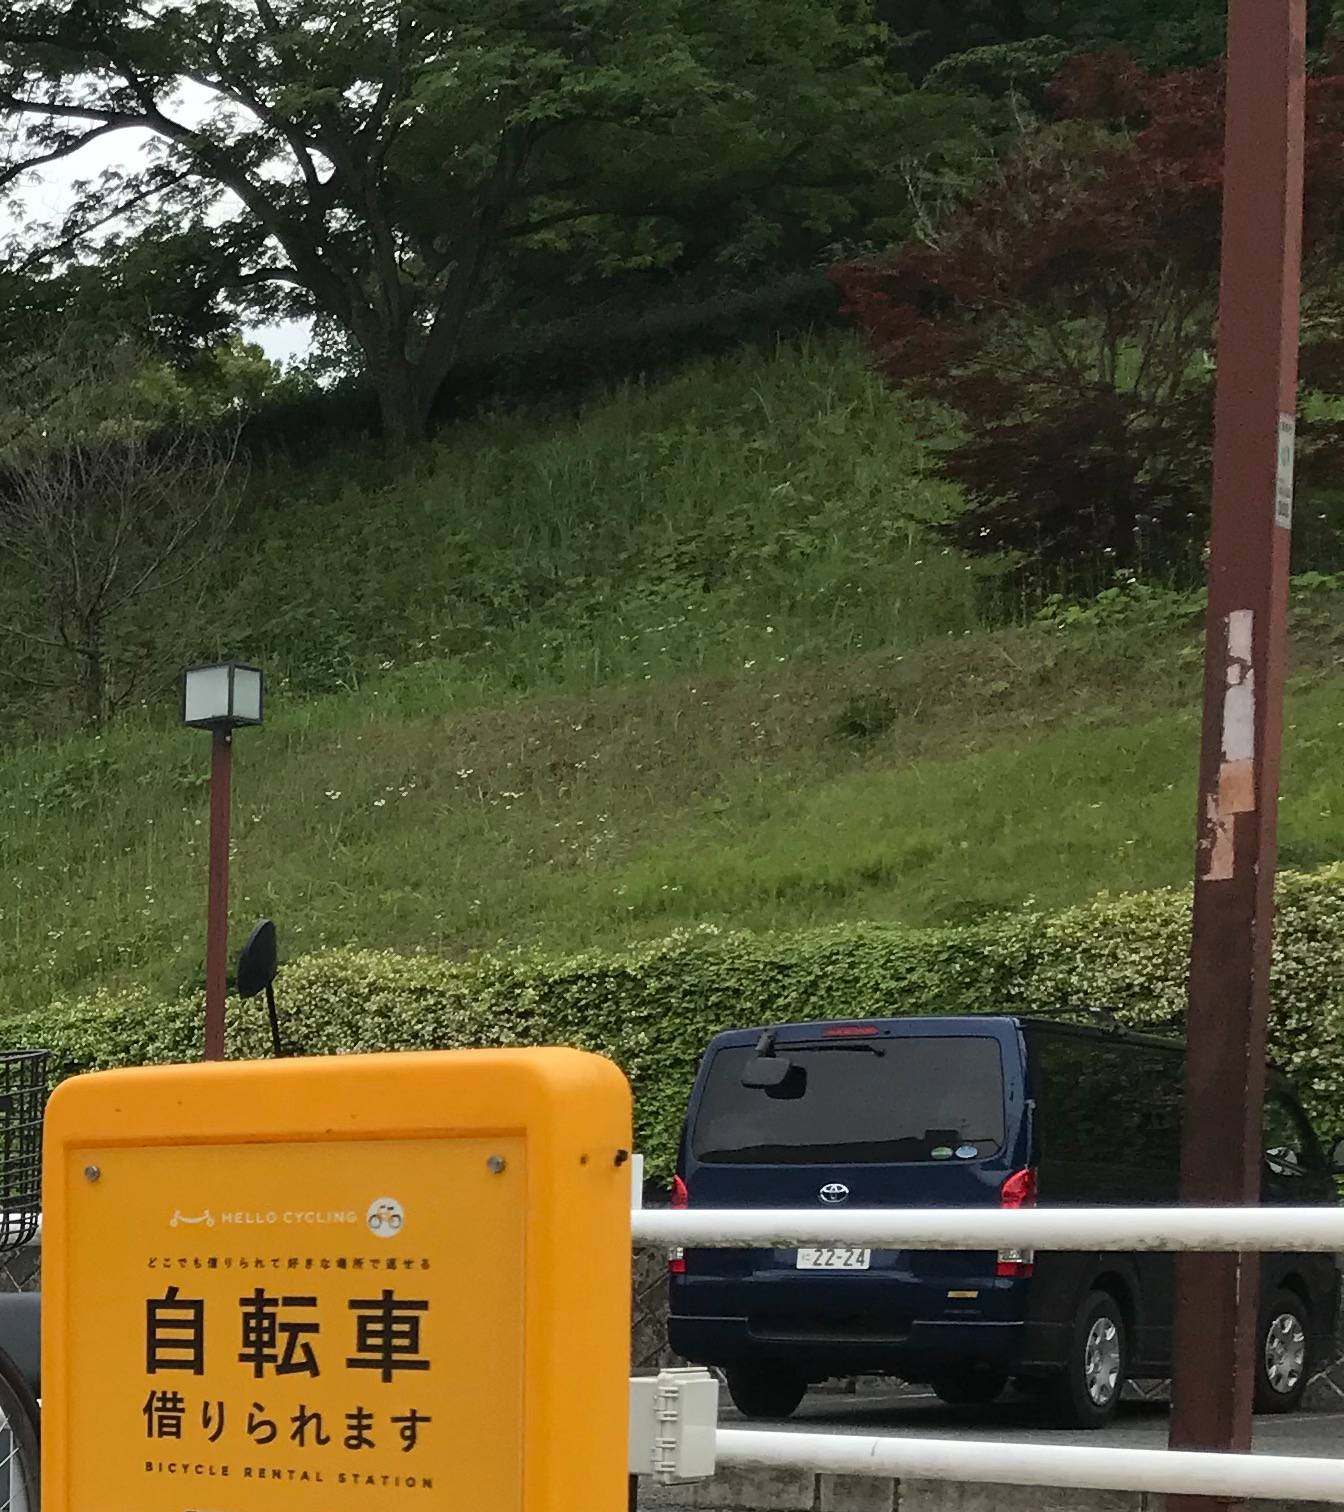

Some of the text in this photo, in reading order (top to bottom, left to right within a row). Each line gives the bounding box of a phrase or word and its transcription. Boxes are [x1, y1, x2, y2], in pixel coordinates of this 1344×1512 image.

[221, 1210, 358, 1224] HELLO CYCLING
[144, 1285, 431, 1384] 自転車
[142, 1389, 432, 1453] 借りられます
[144, 1461, 433, 1489] BICYCLE RENTAL STATION
